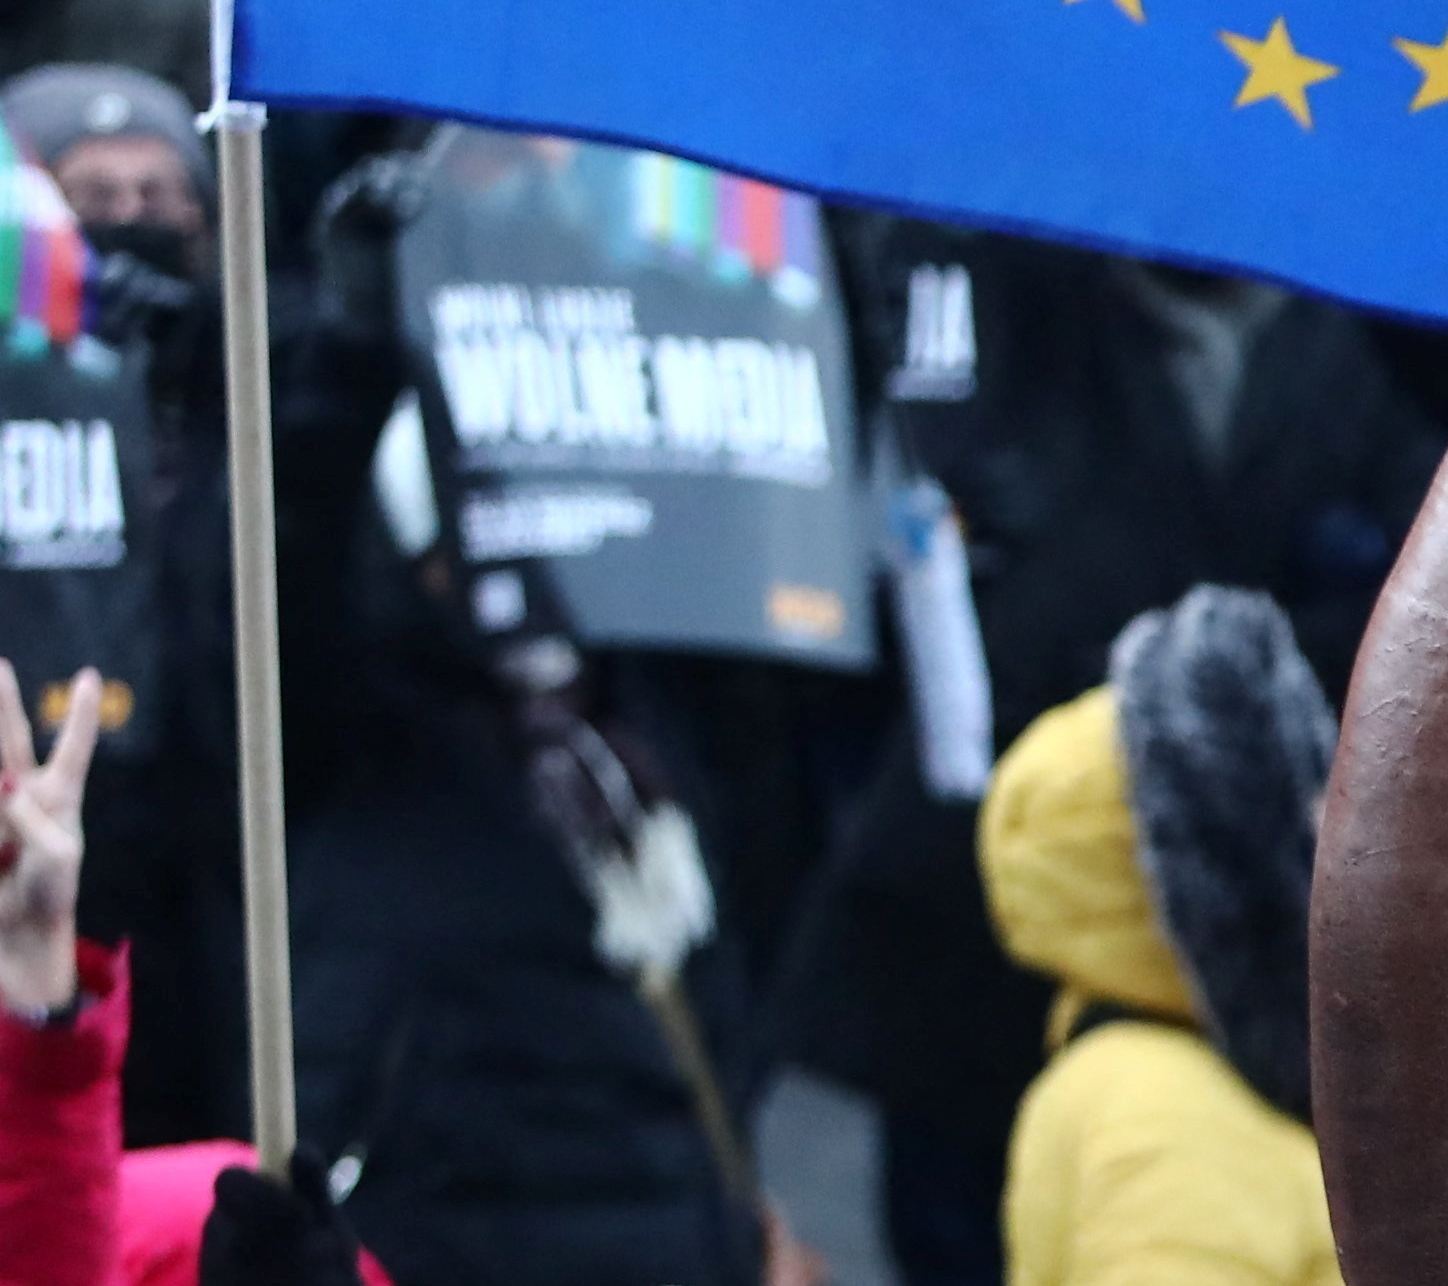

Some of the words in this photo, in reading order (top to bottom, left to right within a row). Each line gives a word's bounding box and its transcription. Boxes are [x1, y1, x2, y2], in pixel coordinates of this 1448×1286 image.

[435, 327, 658, 448] WOLNE
[656, 335, 831, 455] MEDIA
[0, 418, 126, 537] EDIA
